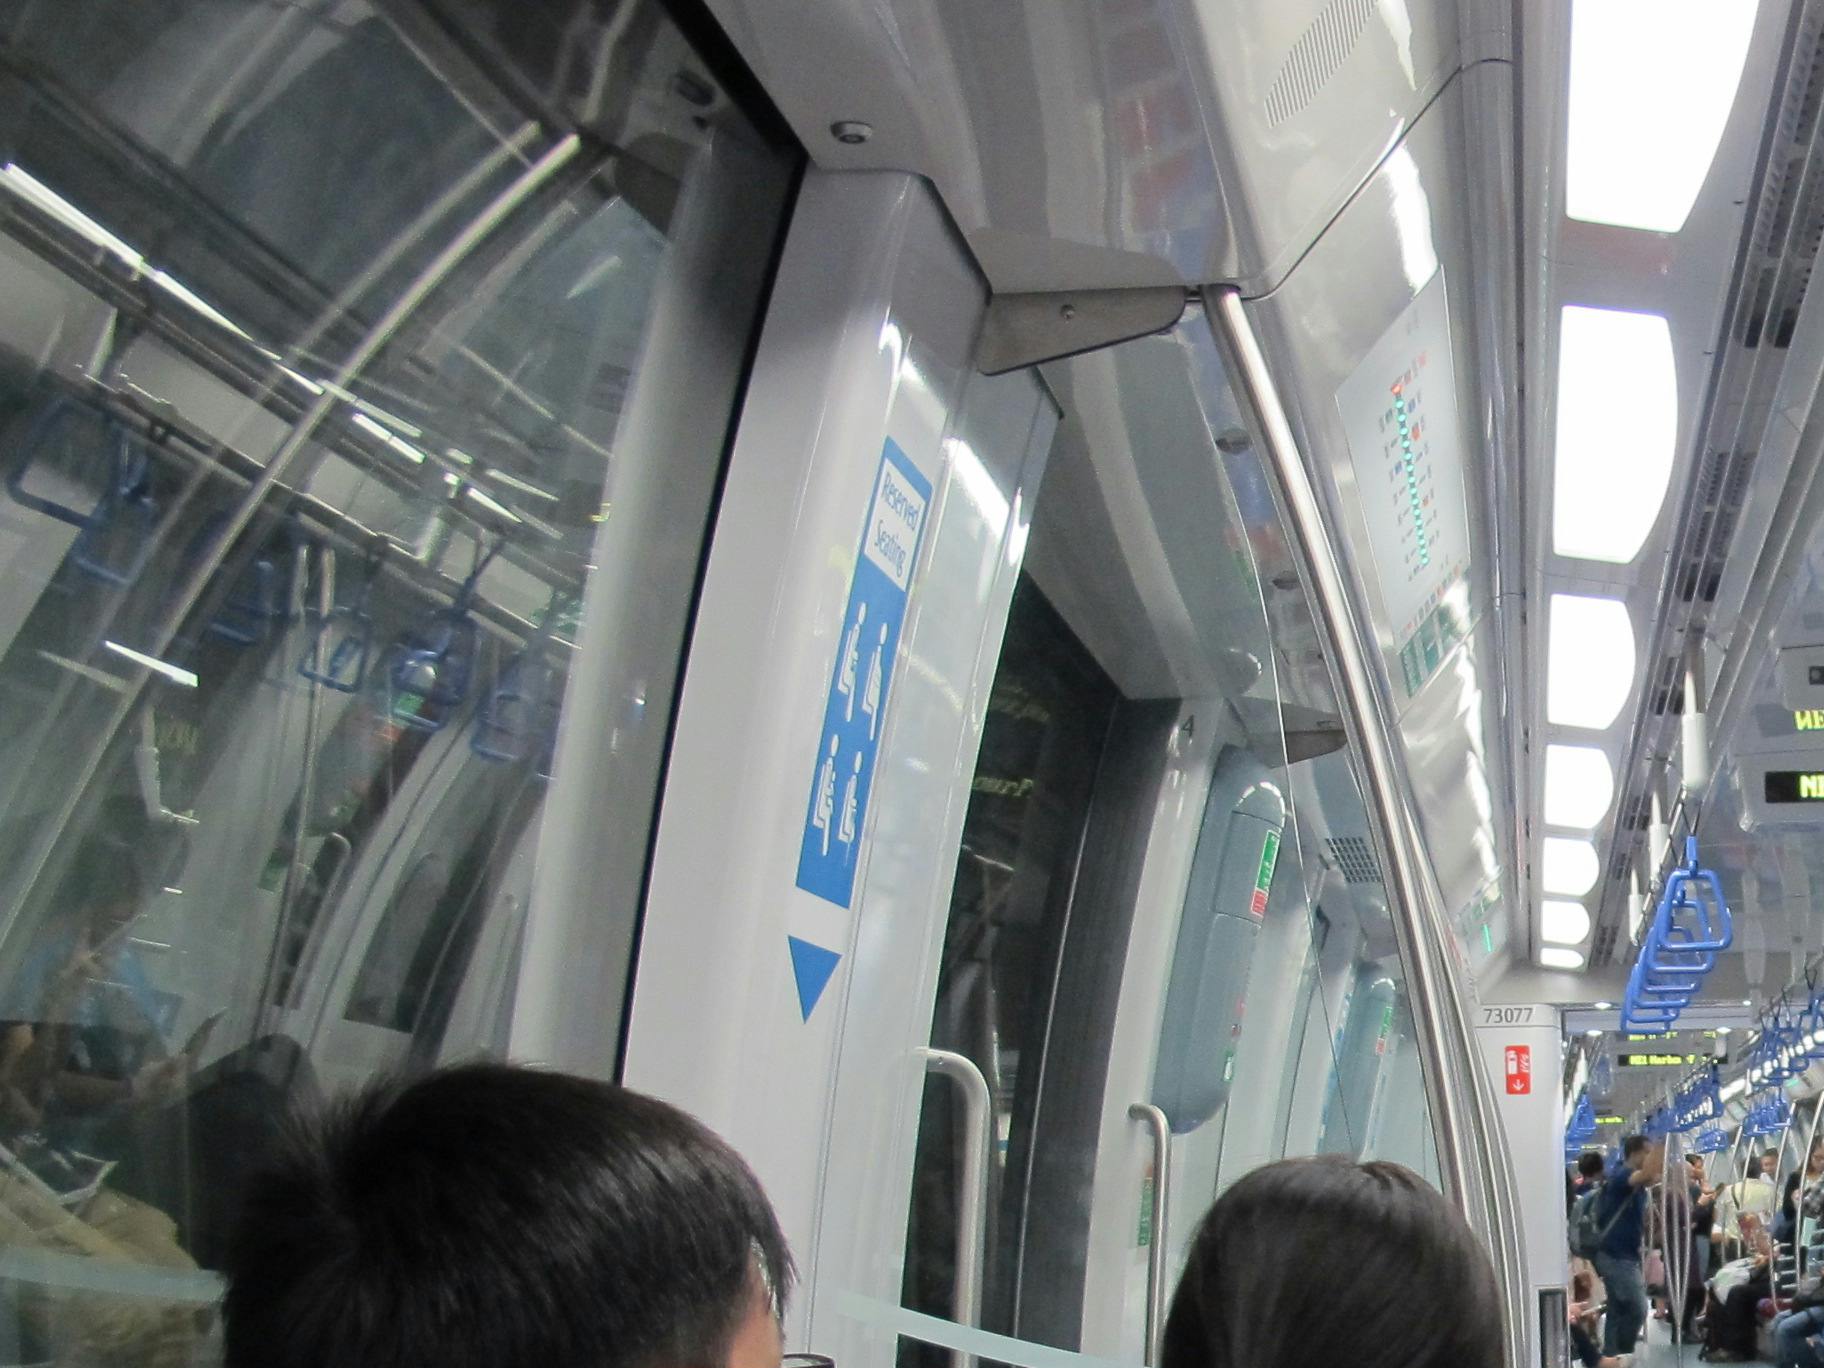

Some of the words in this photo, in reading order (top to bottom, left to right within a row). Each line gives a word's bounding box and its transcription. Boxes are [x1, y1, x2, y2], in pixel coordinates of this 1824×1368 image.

[882, 473, 921, 531] Reserved
[874, 519, 906, 578] Seating
[1182, 714, 1195, 738] 4
[1483, 1007, 1533, 1024] 73077
